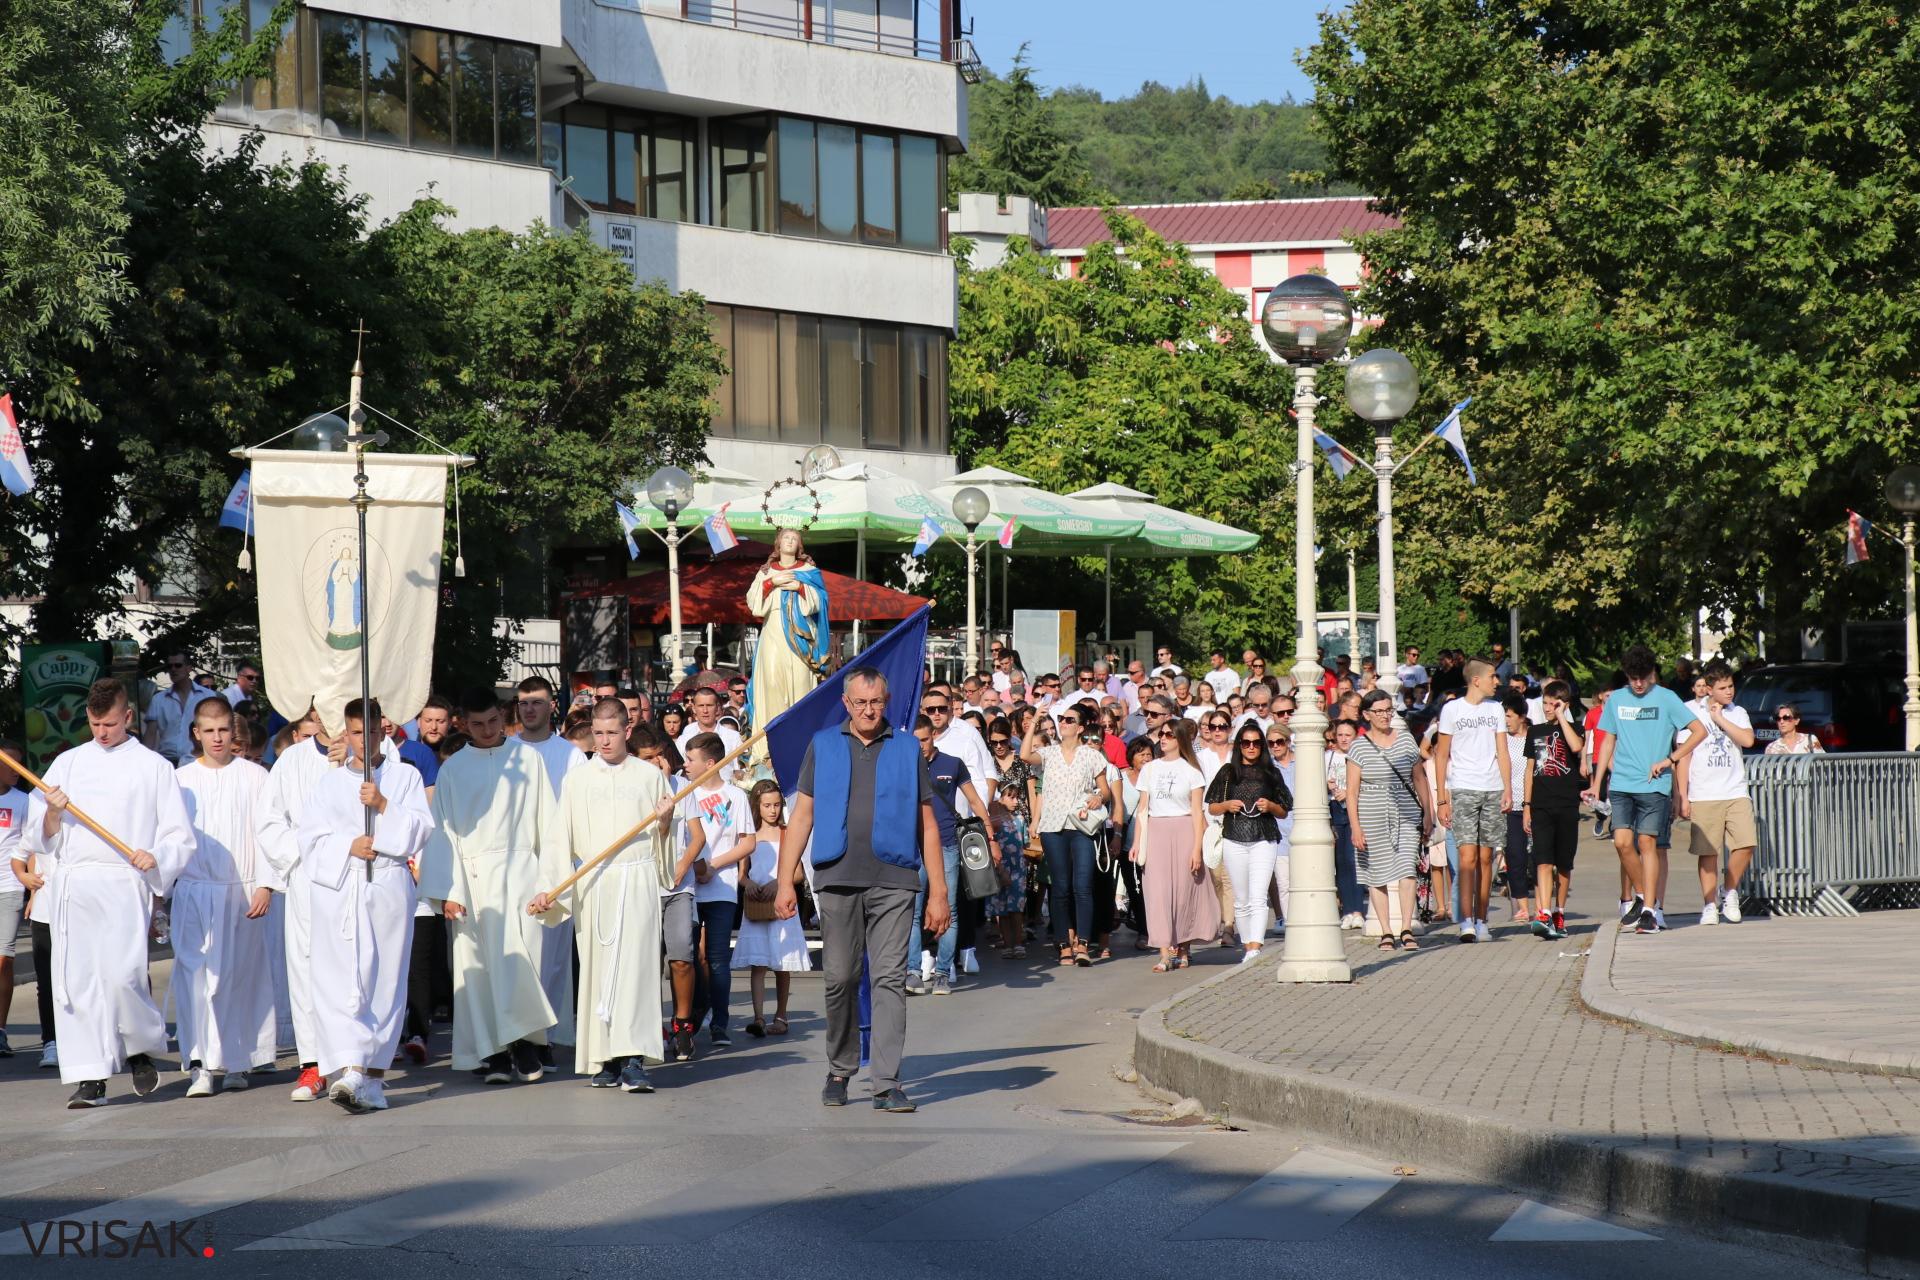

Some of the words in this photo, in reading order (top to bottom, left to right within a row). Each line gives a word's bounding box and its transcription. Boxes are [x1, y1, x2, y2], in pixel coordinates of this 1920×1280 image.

[1057, 519, 1093, 532] SOMERSBY
[1180, 533, 1213, 547] SOMERSBY
[38, 661, 89, 680] Cappy
[1707, 755, 1732, 768] STATE
